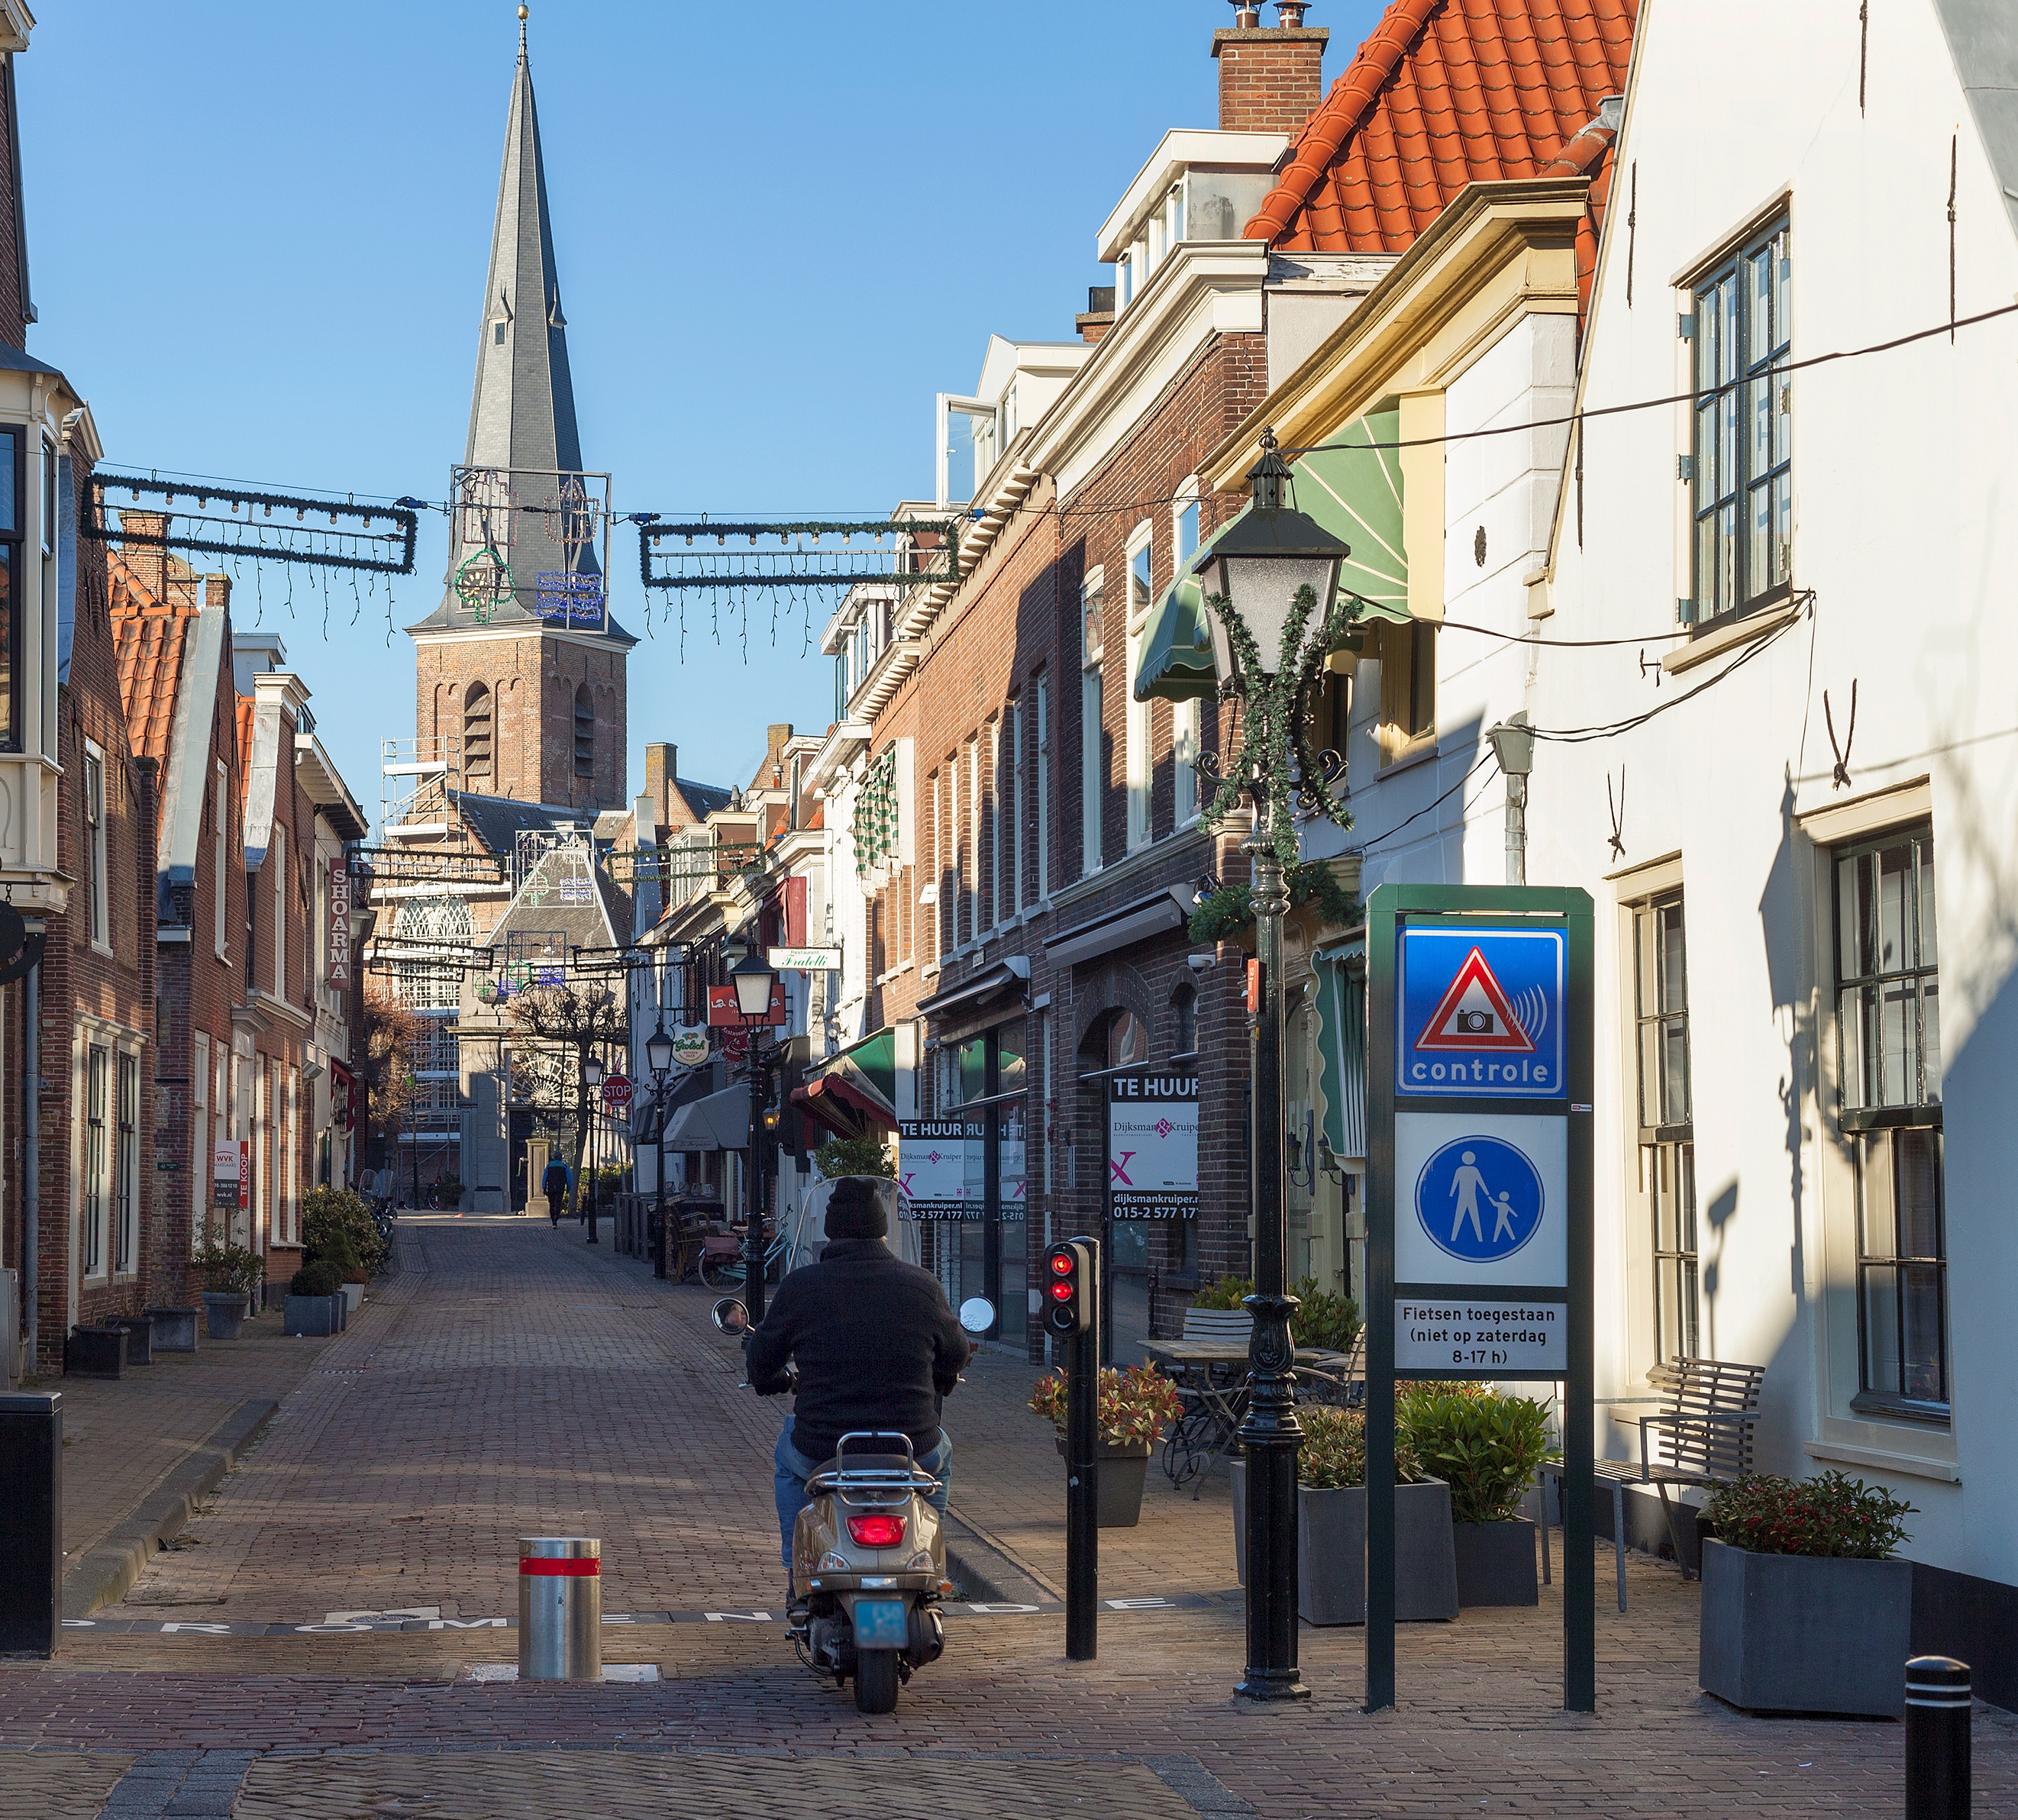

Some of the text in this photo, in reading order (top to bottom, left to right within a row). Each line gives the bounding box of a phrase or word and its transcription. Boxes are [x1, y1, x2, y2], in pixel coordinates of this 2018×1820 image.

[330, 869, 349, 979] SHOARMA
[782, 954, 828, 966] Fratelli
[675, 1039, 705, 1052] Grolsch
[1413, 1059, 1548, 1083] controle
[603, 1085, 631, 1097] STOP
[1113, 1078, 1138, 1096] TE
[900, 1123, 962, 1136] TE HUUR
[1114, 1121, 1156, 1134] Dijksman
[1170, 1121, 1198, 1134] Kruipe
[900, 1153, 929, 1161] Dijksman
[938, 1153, 962, 1162] Kruiper
[241, 1185, 247, 1196] TE
[928, 1211, 944, 1219] 577
[946, 1211, 962, 1219] 177
[1113, 1206, 1198, 1218] 015-2 577 17
[1403, 1307, 1555, 1325] Fietsen toegestaan
[1410, 1328, 1547, 1346] (niet op zaterdag
[1452, 1350, 1507, 1364] 8-17 h)
